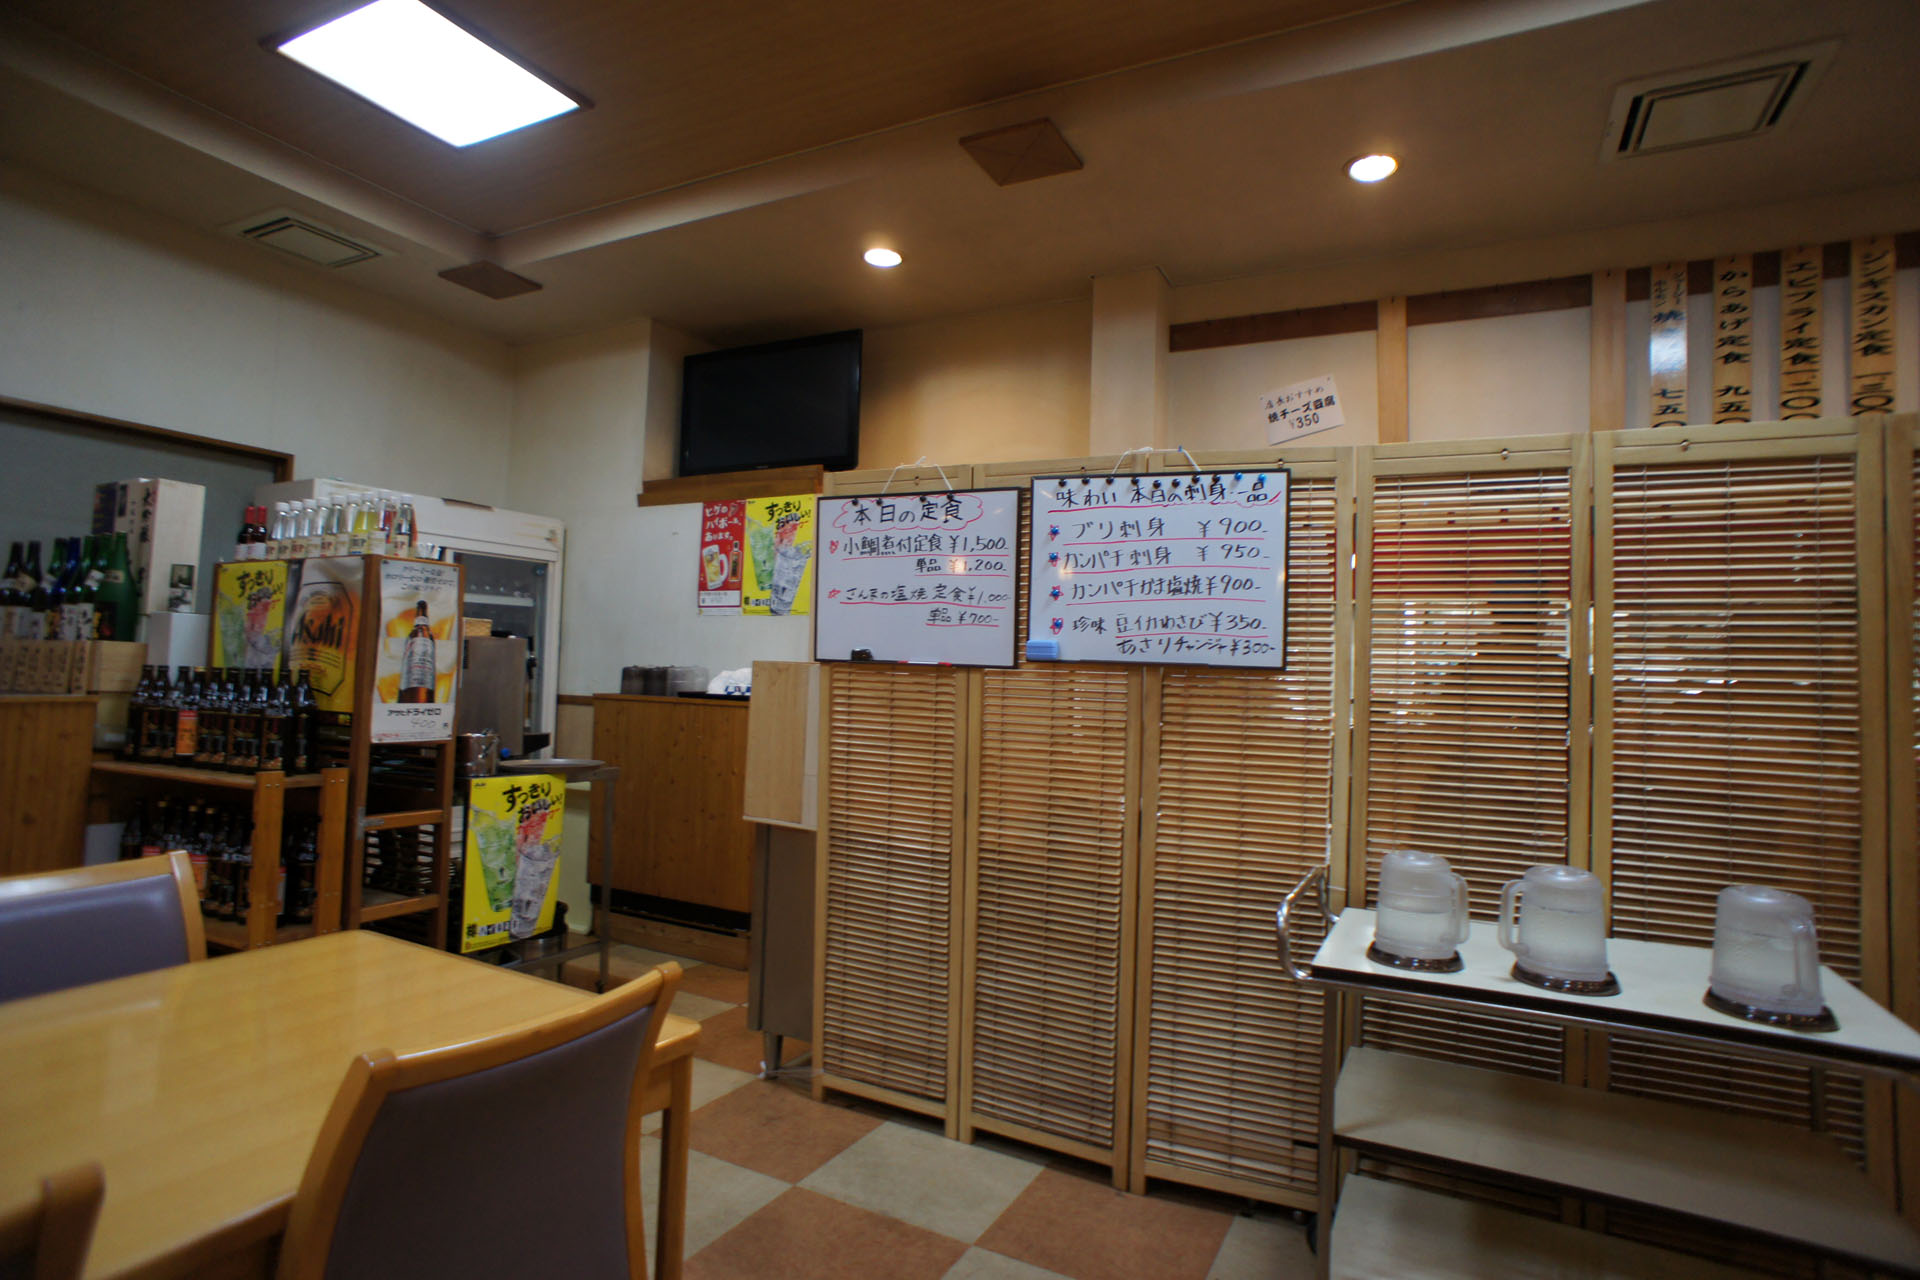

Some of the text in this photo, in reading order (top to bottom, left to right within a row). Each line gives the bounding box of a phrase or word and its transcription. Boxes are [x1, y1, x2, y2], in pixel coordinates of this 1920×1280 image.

[1714, 270, 1751, 365] からあげ定食
[765, 501, 802, 521] すっきり
[853, 499, 964, 525] 本日の定食
[1071, 517, 1165, 540] ブリ刺身
[915, 557, 942, 573] 単品
[1063, 546, 1172, 569] カンパチ刺身
[236, 569, 274, 598] すっきり
[927, 608, 952, 623] 単品
[1072, 616, 1108, 634] 珍味
[502, 782, 552, 813] すっきり
